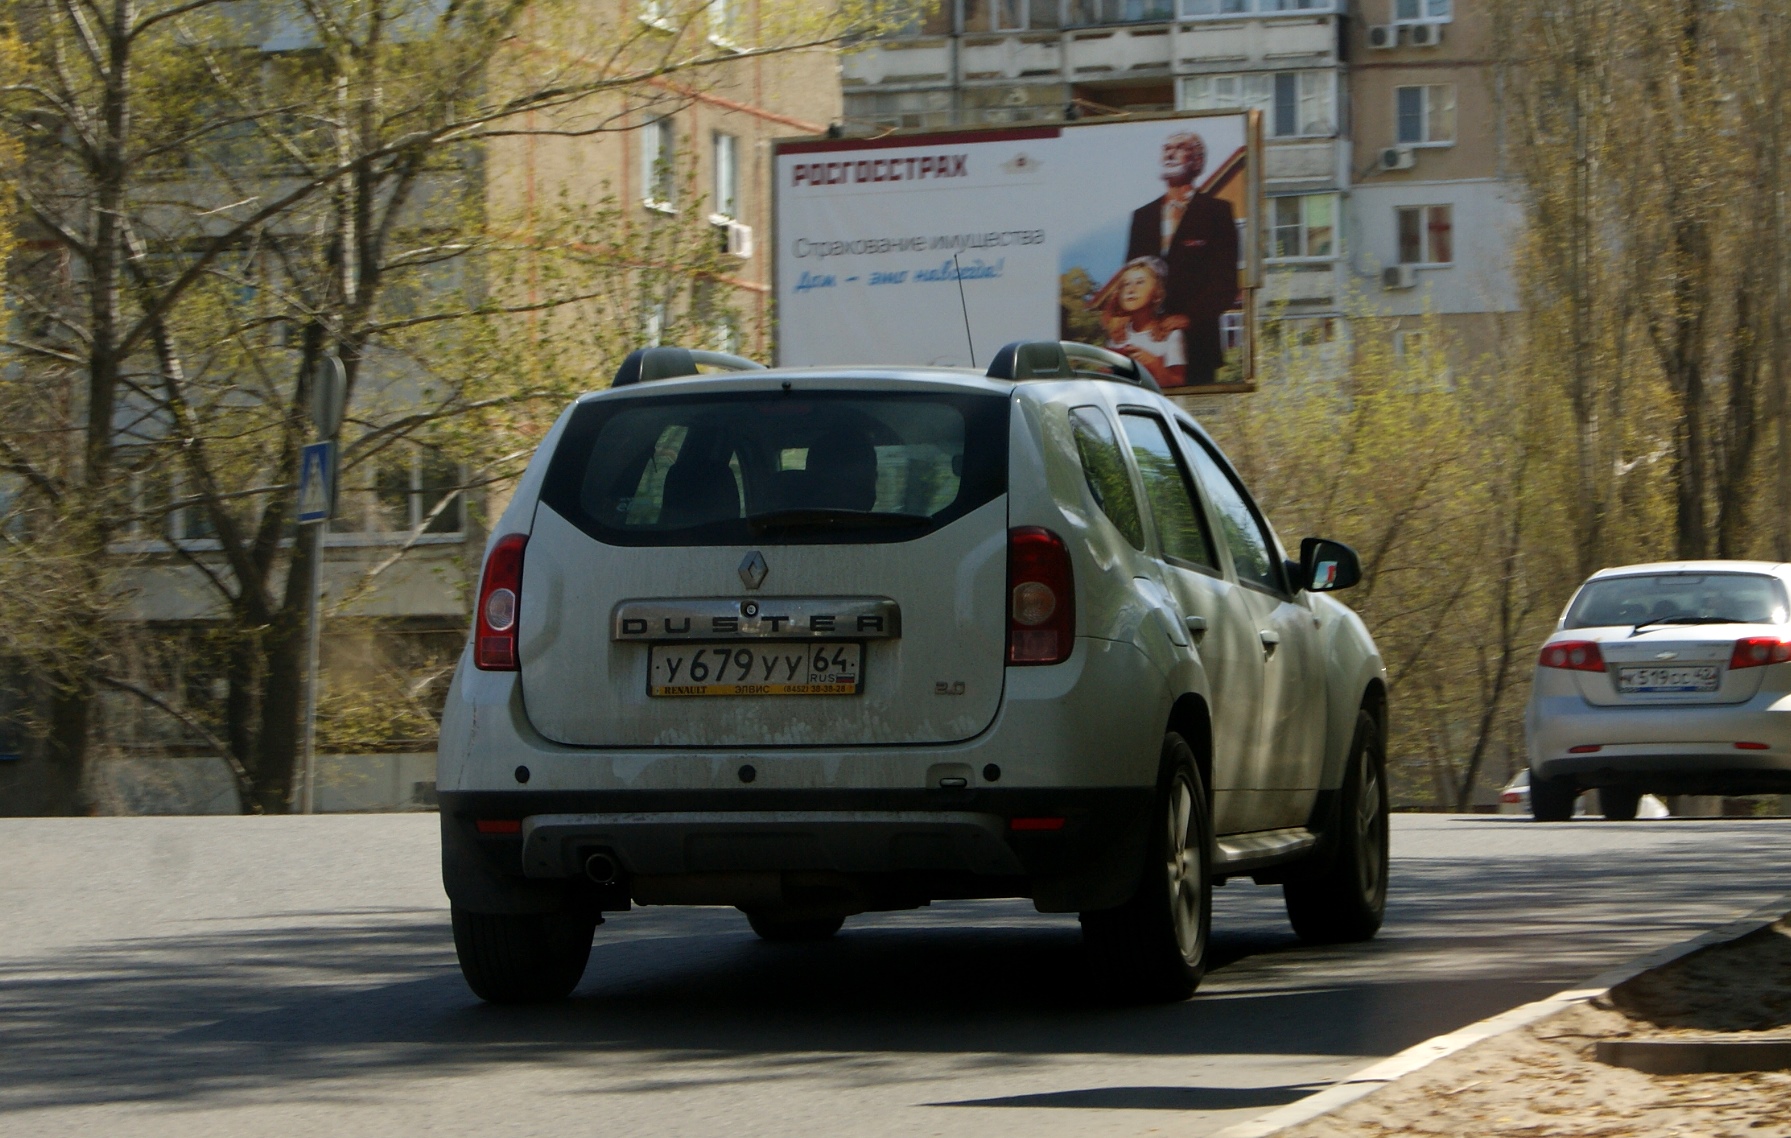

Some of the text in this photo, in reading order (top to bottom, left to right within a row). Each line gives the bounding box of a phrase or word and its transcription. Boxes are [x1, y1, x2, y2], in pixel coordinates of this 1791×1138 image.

[791, 153, 968, 187] РОСГОССТРАХ
[792, 228, 1047, 260] Страхование имущества
[622, 615, 885, 635] DUSTER
[812, 646, 847, 673] 64
[809, 673, 836, 683] RUS
[664, 685, 708, 694] RENAULT
[734, 685, 771, 694] ЭЛВИС
